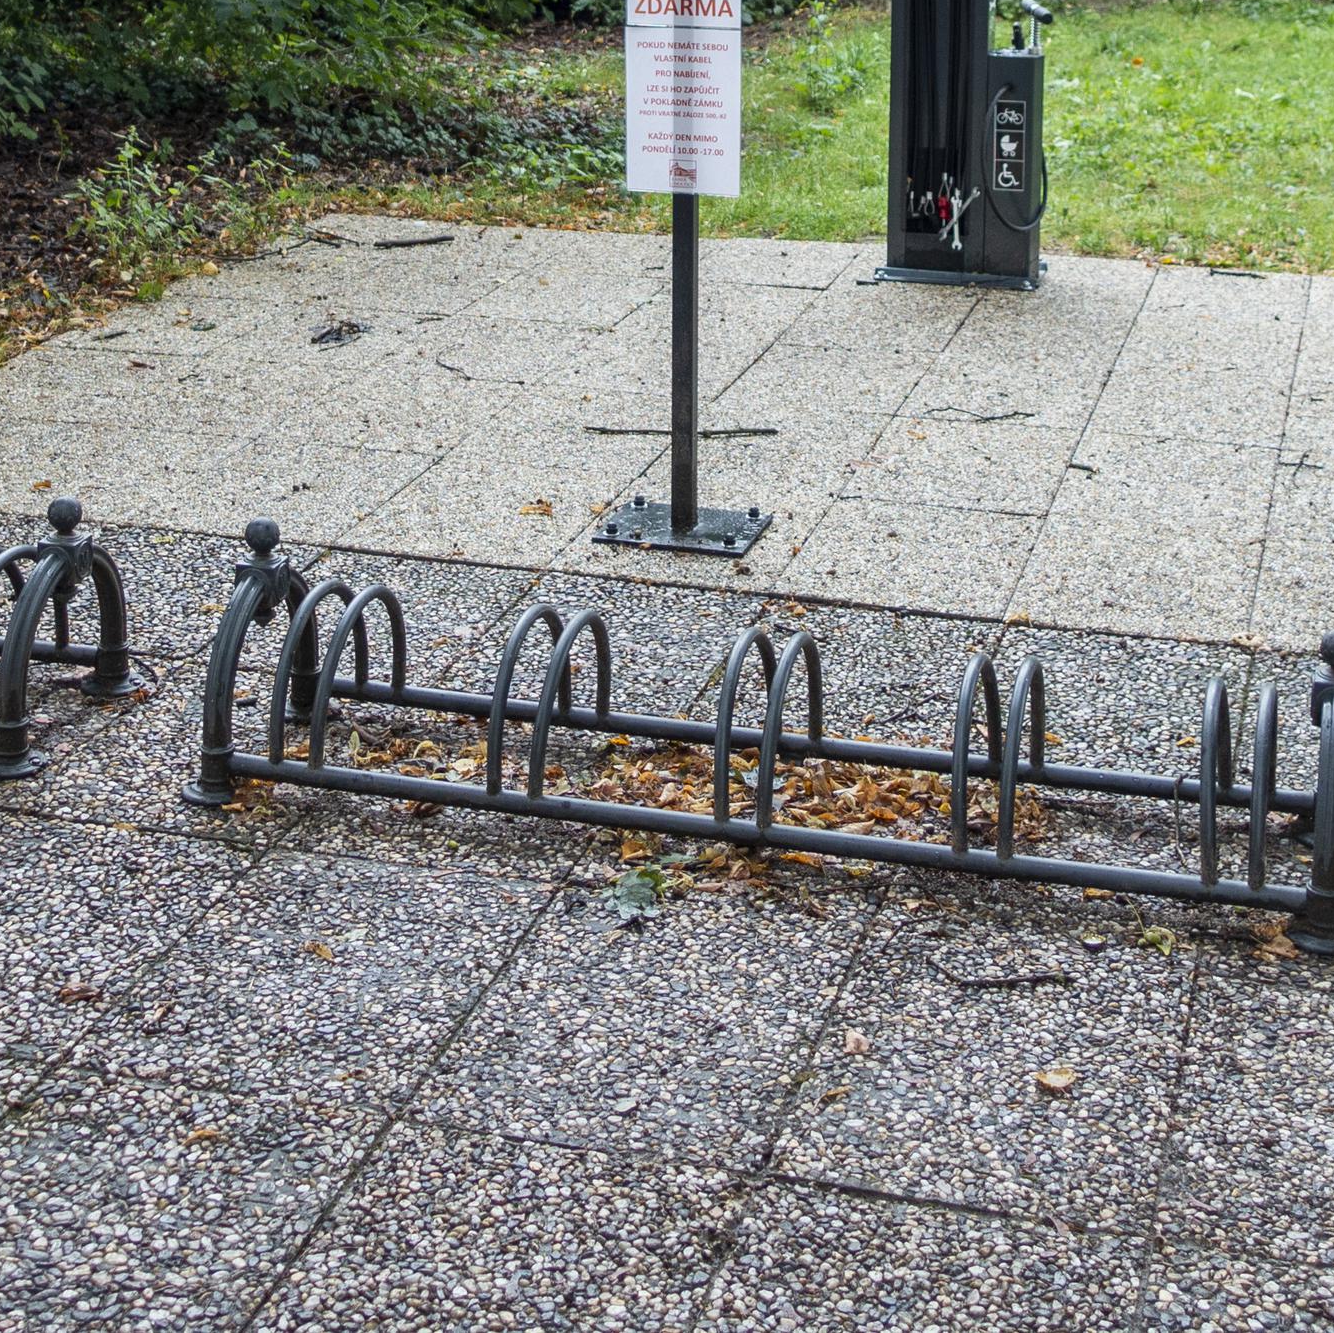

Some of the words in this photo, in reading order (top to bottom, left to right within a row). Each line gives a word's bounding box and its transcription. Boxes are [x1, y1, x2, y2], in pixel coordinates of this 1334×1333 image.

[667, 41, 700, 50] NEMÁTE
[702, 43, 729, 51] SEBOU
[653, 54, 687, 63] VLASTNÍ
[688, 56, 712, 64] KABEL
[655, 69, 671, 77] PRO
[646, 85, 659, 93] LZE
[661, 85, 668, 93] SI
[670, 85, 682, 94] HO
[693, 99, 723, 108] ZÁMKU
[693, 135, 718, 143] MIMO
[677, 147, 698, 155] 10.00
